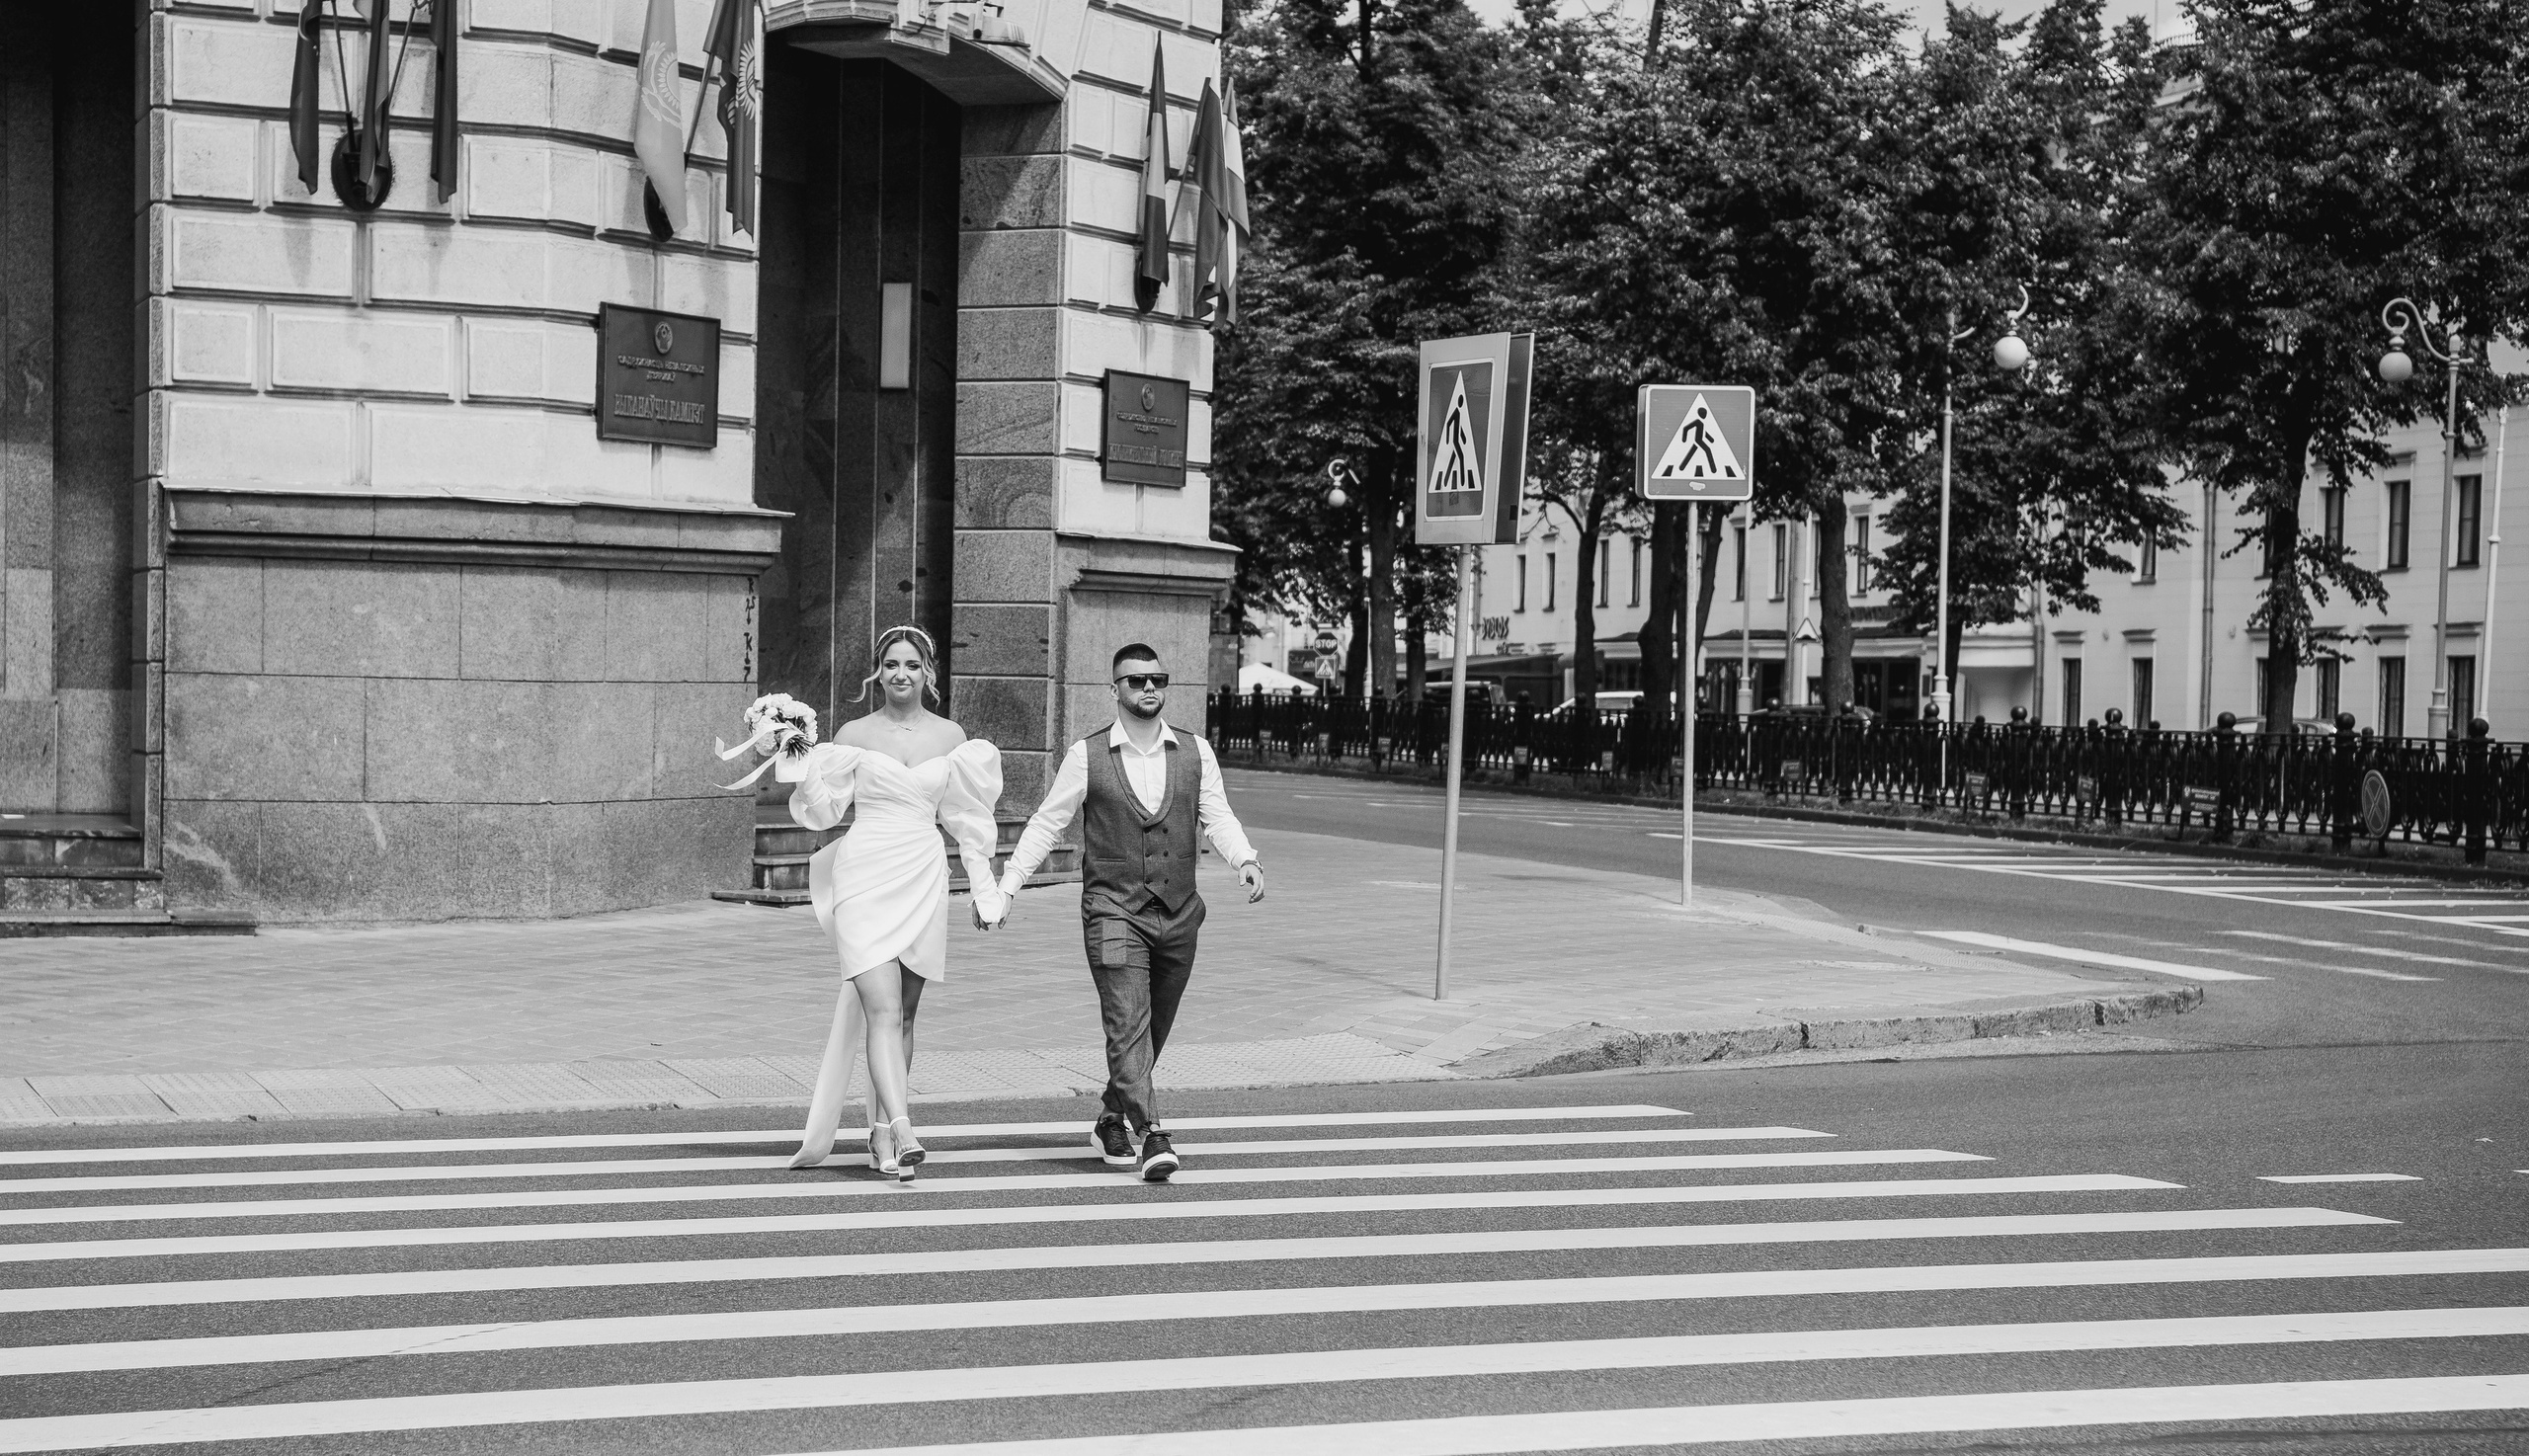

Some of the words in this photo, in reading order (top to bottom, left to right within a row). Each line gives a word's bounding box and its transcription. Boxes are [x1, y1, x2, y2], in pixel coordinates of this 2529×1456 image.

[614, 394, 668, 419] ВЫКАНАЎЧЫ
[669, 400, 705, 424] КАМІТЭТ
[1315, 639, 1338, 649] STOP
